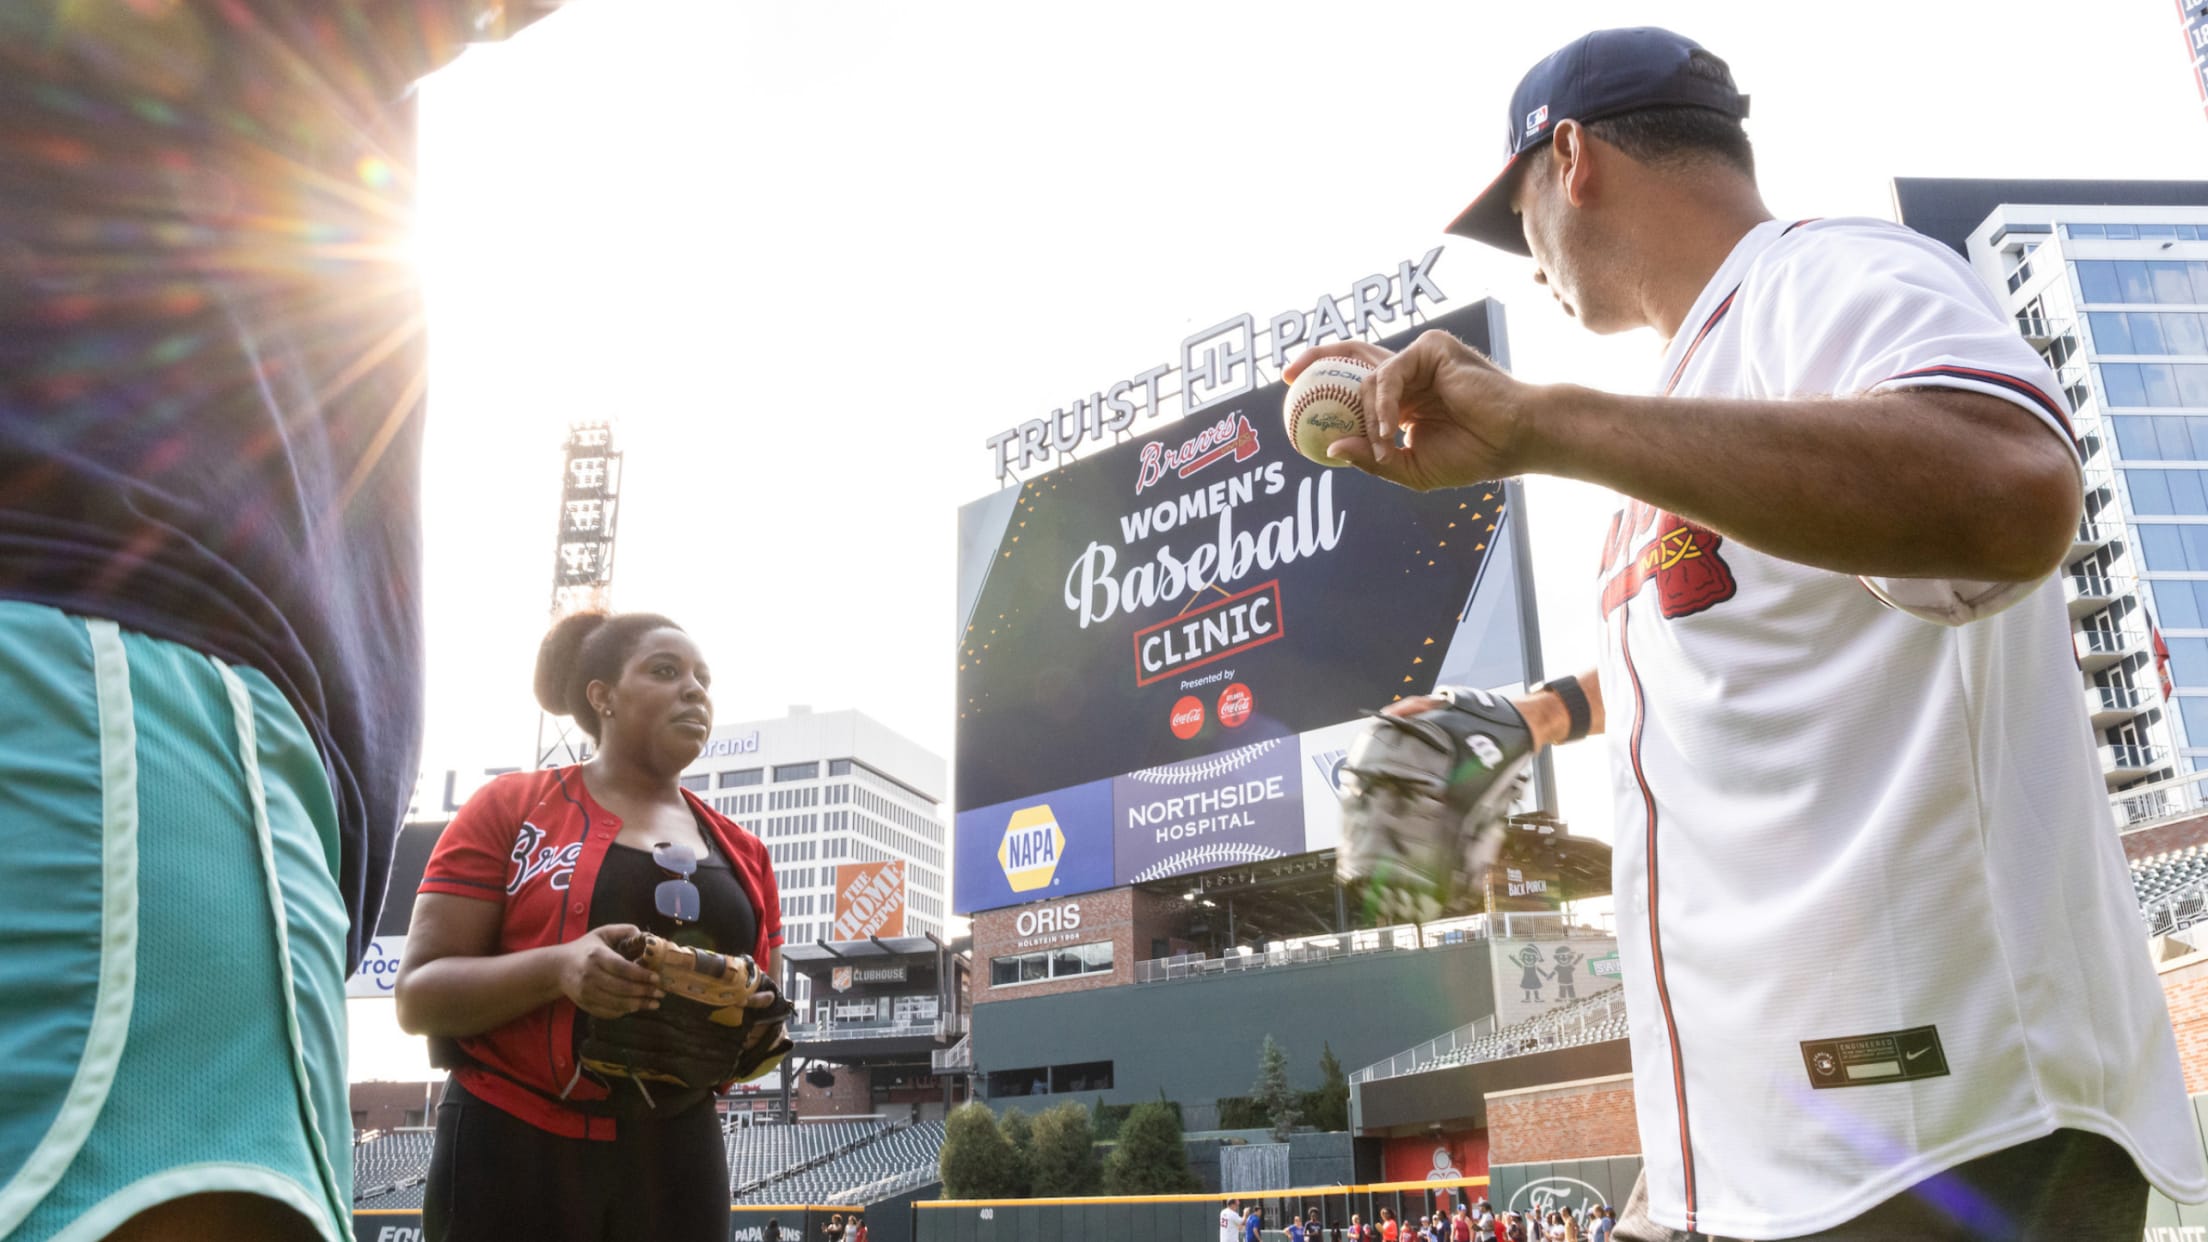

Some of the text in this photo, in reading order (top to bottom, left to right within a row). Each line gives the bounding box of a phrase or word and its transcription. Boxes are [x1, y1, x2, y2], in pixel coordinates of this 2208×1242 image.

[987, 245, 1449, 479] TRUIST PARK
[1136, 411, 1236, 496] Braves
[1120, 461, 1285, 544] WOMEN'S
[1064, 470, 1346, 629] Baseball
[1142, 597, 1273, 672] CLINIC
[1180, 669, 1236, 690] Presented by
[1128, 776, 1285, 829] NORTHSIDE
[1156, 811, 1256, 844] HOSPITAL
[1008, 829, 1055, 868] NAPA
[835, 860, 904, 941] HOME
[842, 870, 871, 903] THE
[861, 887, 905, 941] DEPOT
[1016, 903, 1080, 937] ORIS
[853, 968, 904, 981] CLUBHOUSE
[735, 1226, 765, 1242] PAPA
